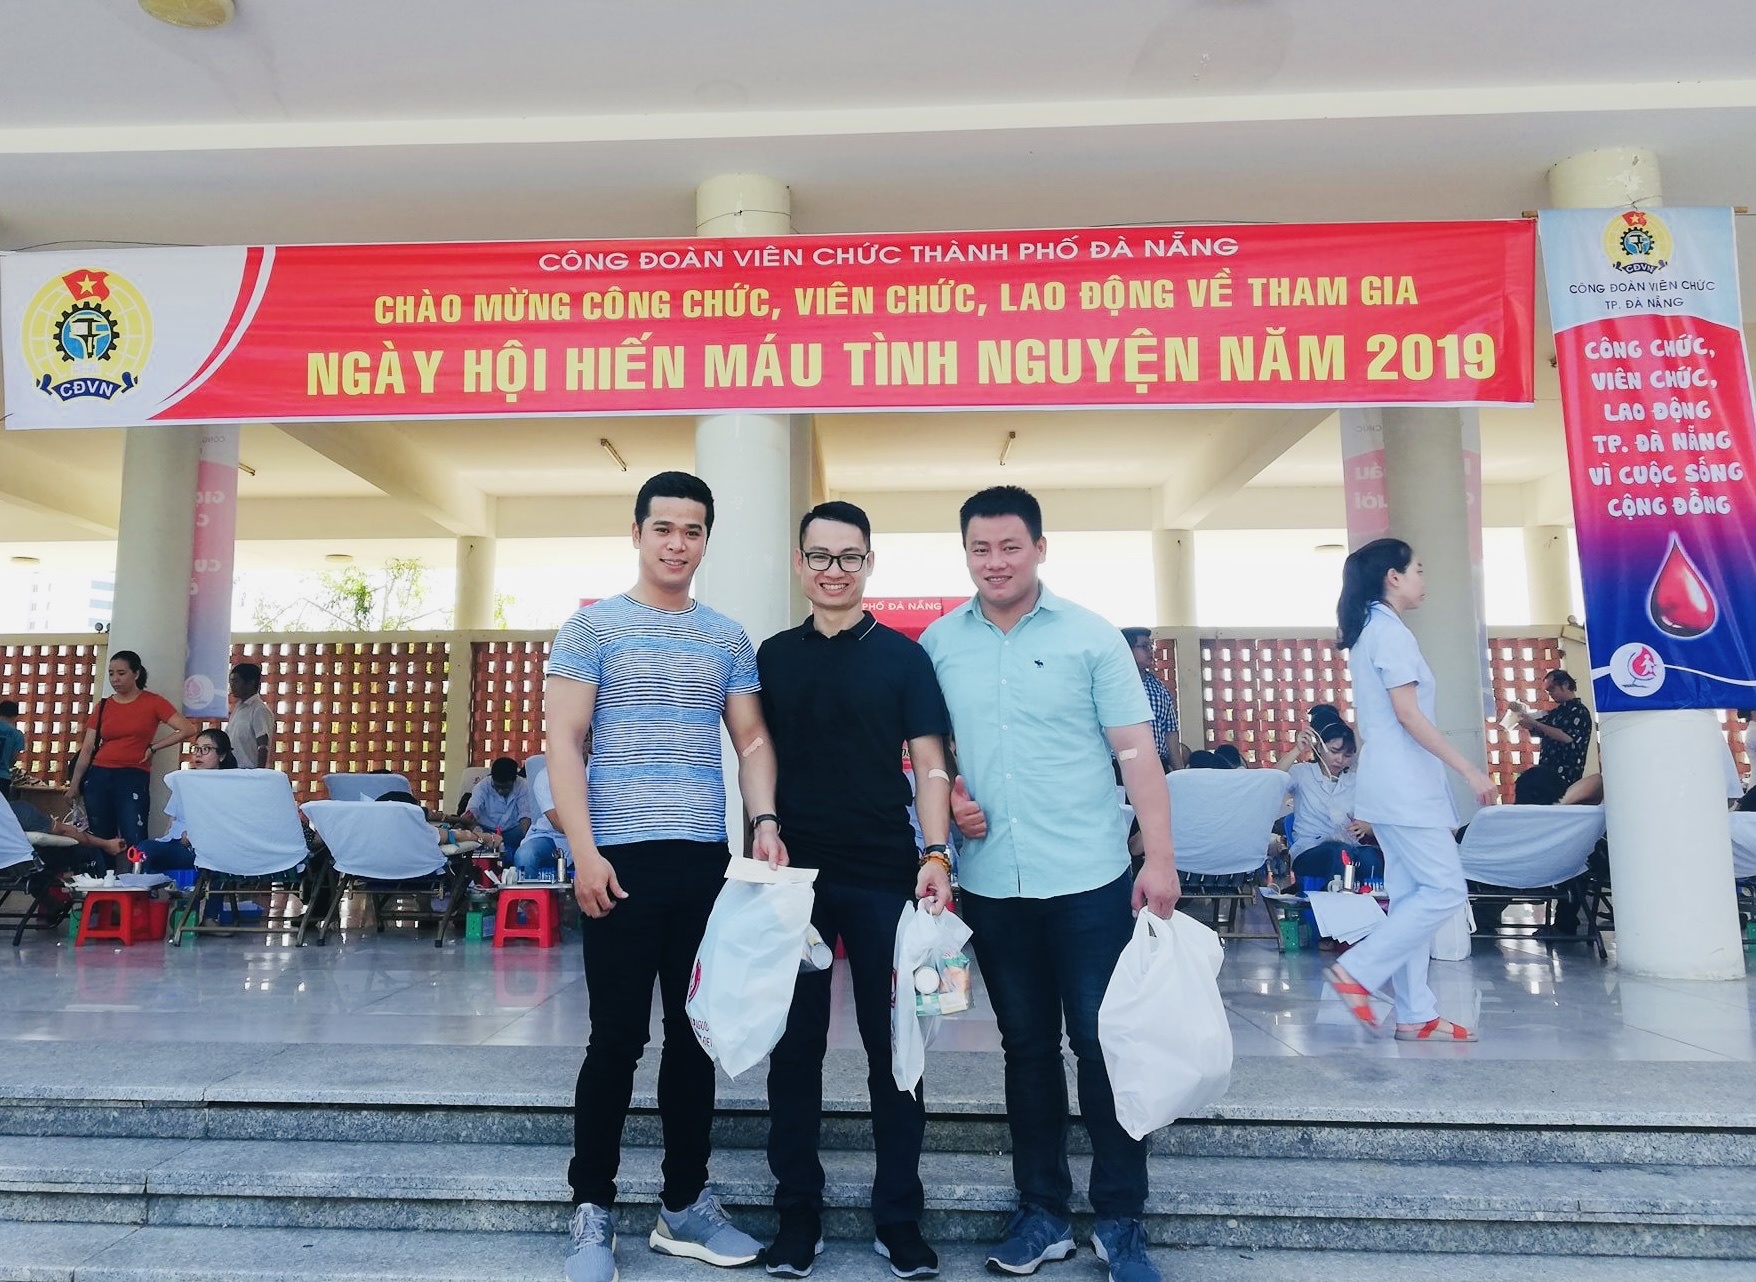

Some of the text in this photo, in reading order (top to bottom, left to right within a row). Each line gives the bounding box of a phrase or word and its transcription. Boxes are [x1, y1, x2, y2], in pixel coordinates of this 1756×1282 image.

[539, 232, 1238, 270] CÔNG ĐOÀN VIÊN CHỨC THÀNH PHỐ ĐÀ NẴNG
[1626, 263, 1655, 274] CĐVN
[375, 268, 1418, 324] CHÀO MỪNG CÔNG CHỨC, VIÊN CHỨC, LAO ĐỘNG VỀ THAM GIA
[1569, 278, 1715, 294] CÔNG ĐOÀN VIÊN CHỨC
[1605, 300, 1621, 310] TP.
[1626, 296, 1643, 308] ĐÀ
[1585, 334, 1714, 359] CÔNG CHỨC,
[308, 327, 1495, 402] NGÀY HỘI HIẾN MÁU TÌNH NGUYỆN NĂM 2019
[60, 380, 113, 396] CĐVN
[1592, 366, 1717, 390] VIÊN CHỨC,
[1605, 397, 1711, 422] LAO ĐỘNG
[1593, 426, 1731, 453] TP. ĐÀ NẴNG
[1589, 457, 1743, 487] VÌ CUỘC SỐNG
[1608, 488, 1730, 520] CỘNG ĐỒNG
[862, 600, 885, 611] PHỐ
[888, 601, 904, 611] ĐÀ
